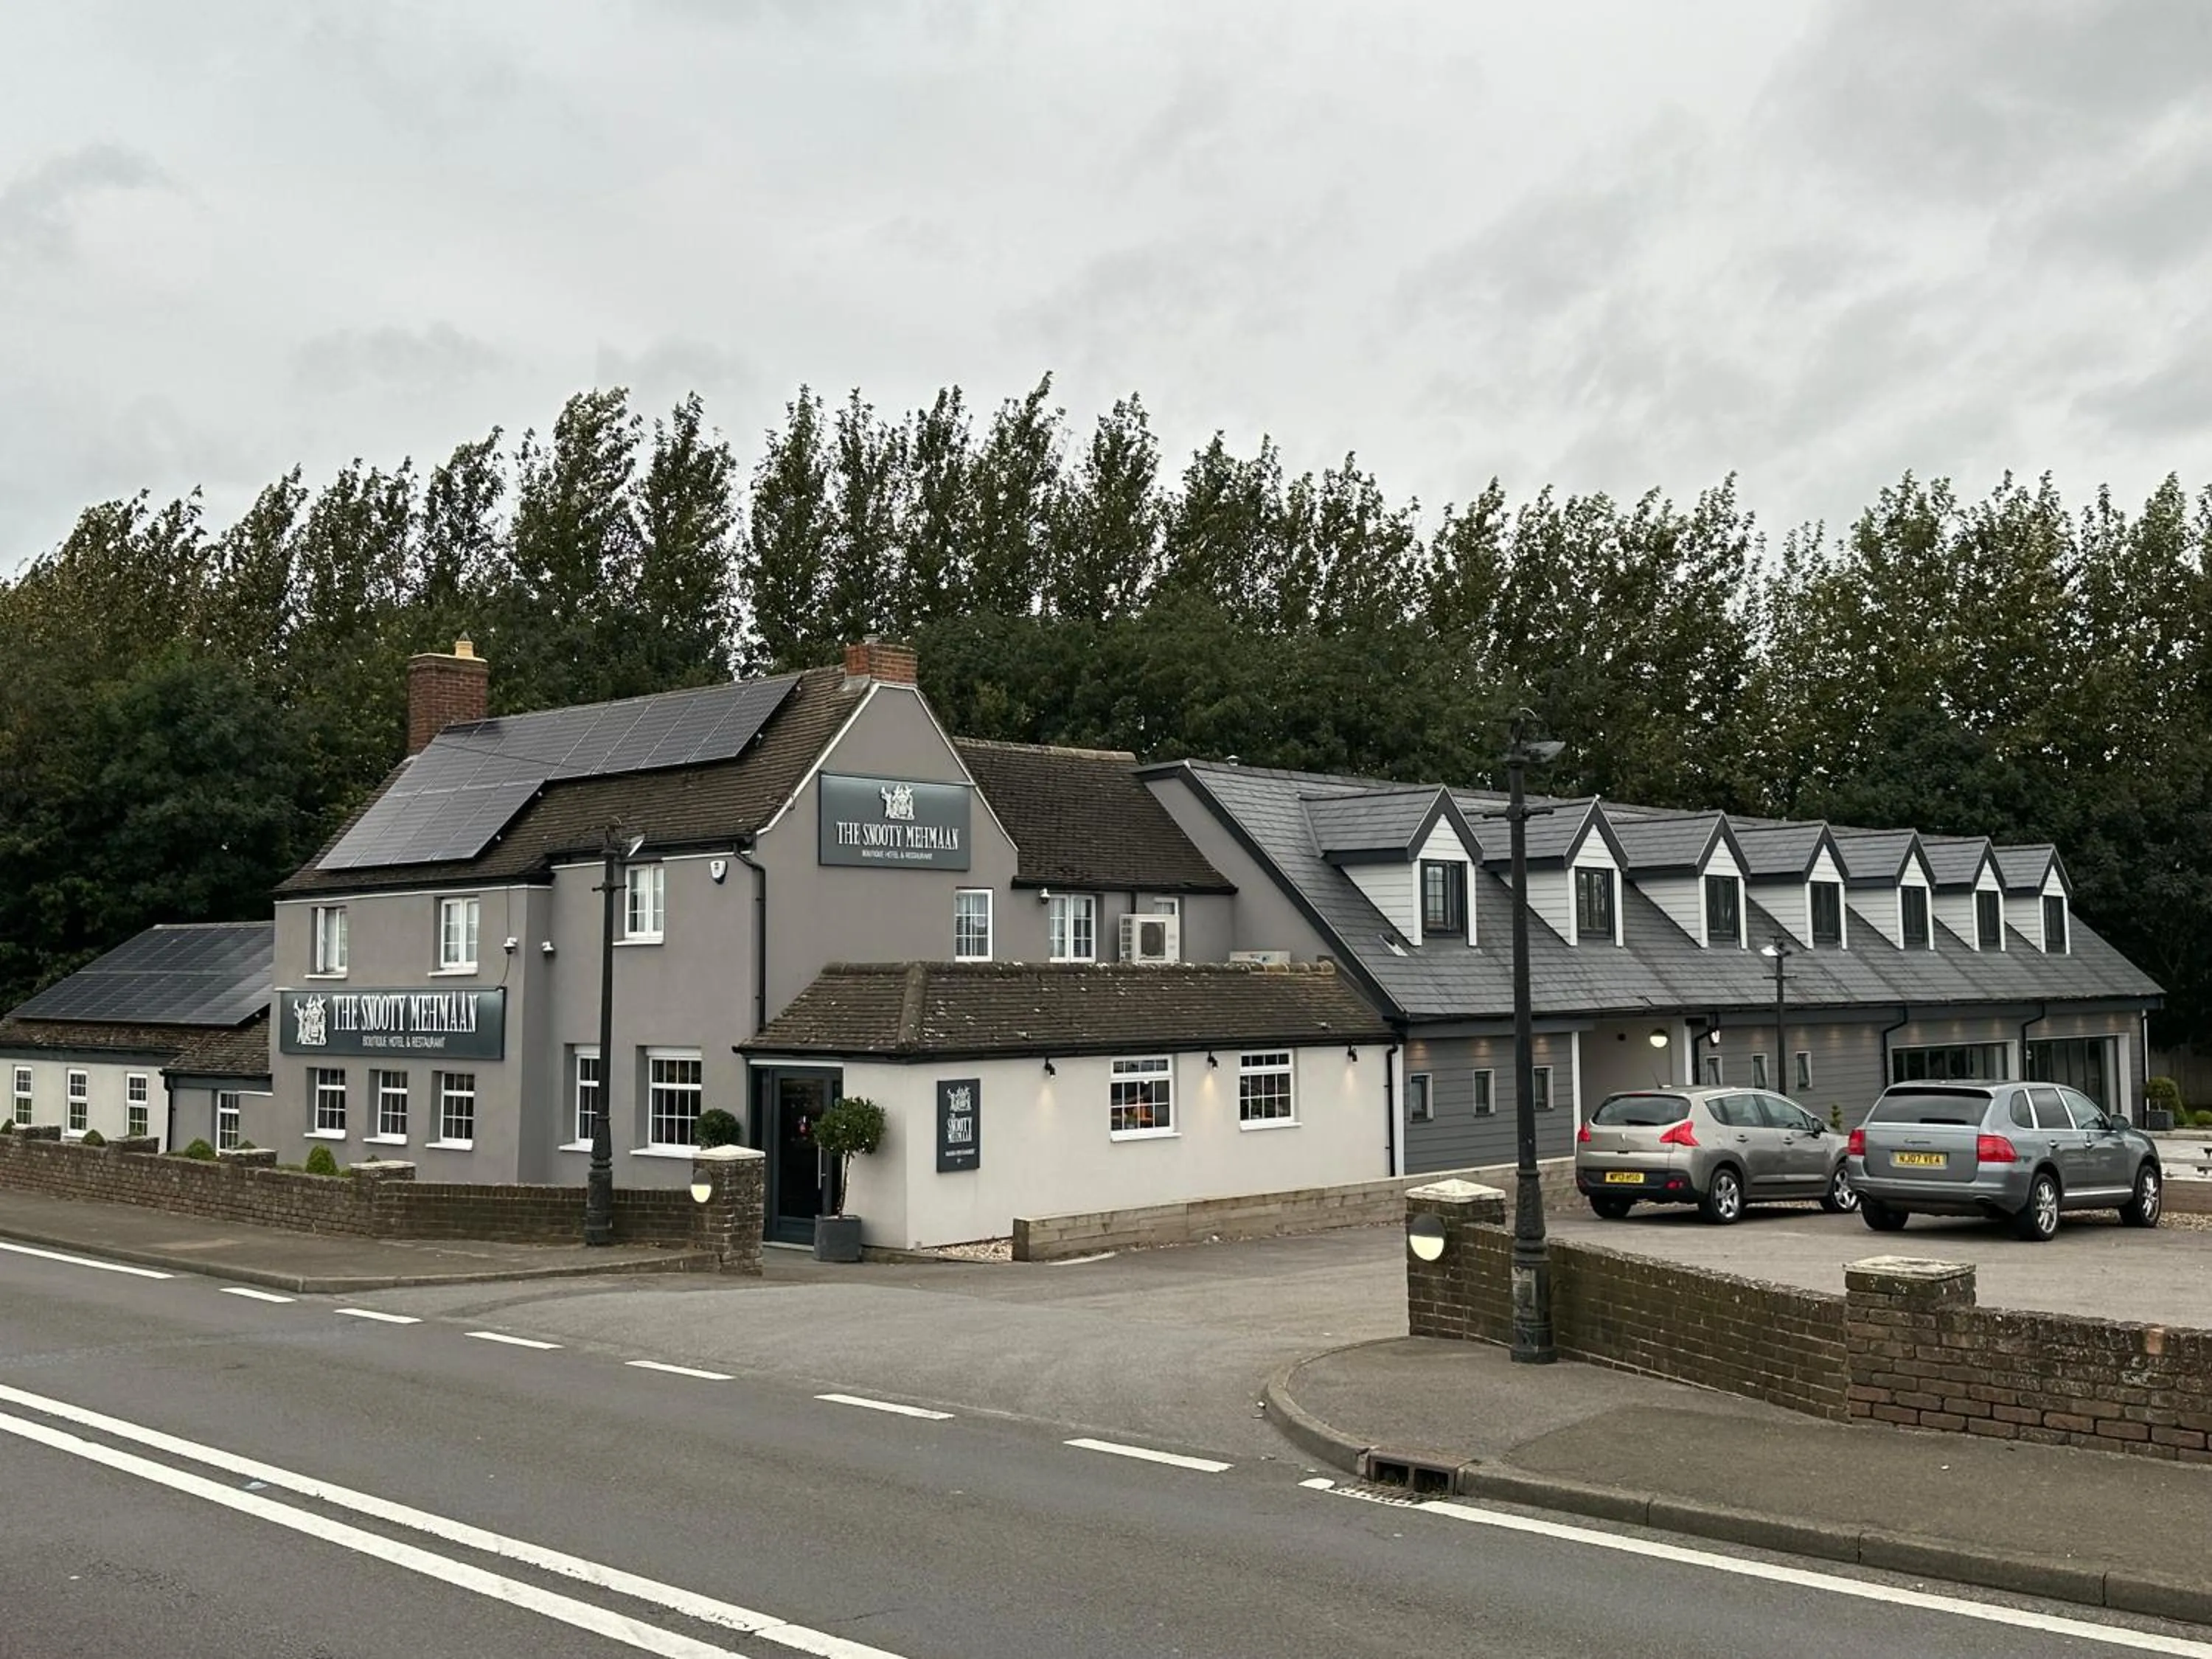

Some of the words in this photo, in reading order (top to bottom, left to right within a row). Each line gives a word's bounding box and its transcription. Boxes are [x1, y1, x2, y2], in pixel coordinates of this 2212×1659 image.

[836, 821, 860, 845] THE
[863, 823, 902, 847] SNOOTY
[333, 994, 358, 1030] THE
[361, 994, 406, 1032] SNOOTY
[362, 1036, 388, 1047] BOUTIQUE
[389, 1036, 405, 1047] HOTEL
[411, 1036, 445, 1048] RESTAURANT
